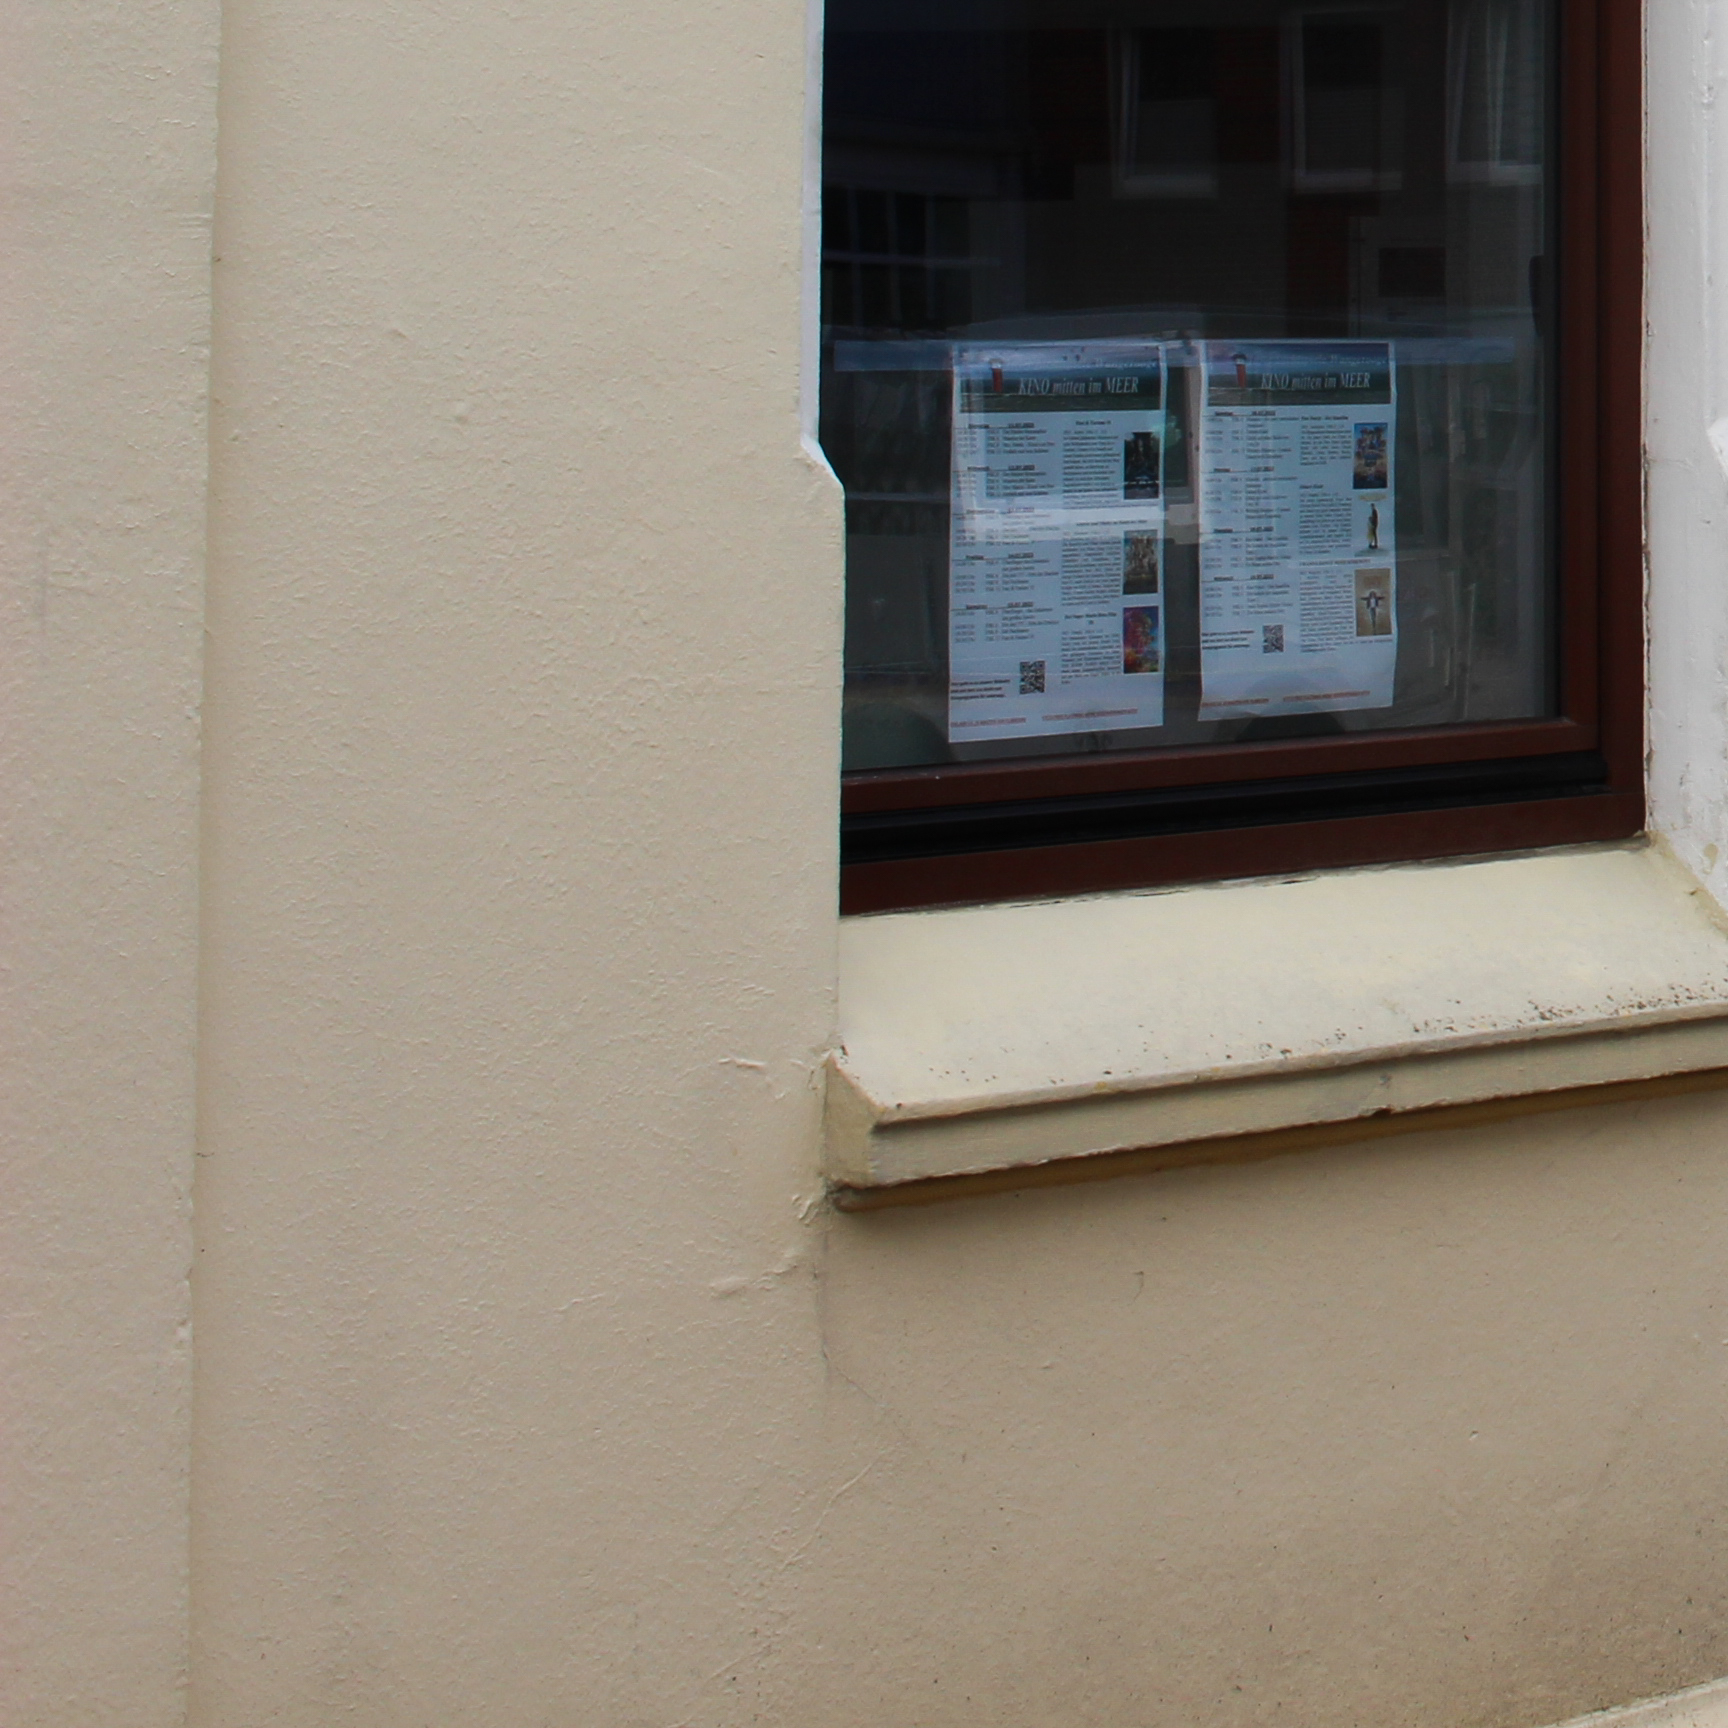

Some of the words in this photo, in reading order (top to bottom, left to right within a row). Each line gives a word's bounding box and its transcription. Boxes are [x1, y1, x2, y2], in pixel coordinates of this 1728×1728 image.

[1018, 377, 1050, 395] KINO
[1052, 378, 1086, 395] mitten
[1088, 377, 1102, 394] im
[1106, 377, 1139, 393] MEER
[1261, 373, 1289, 390] KINO
[1324, 373, 1337, 389] im
[1340, 373, 1371, 388] MEER
